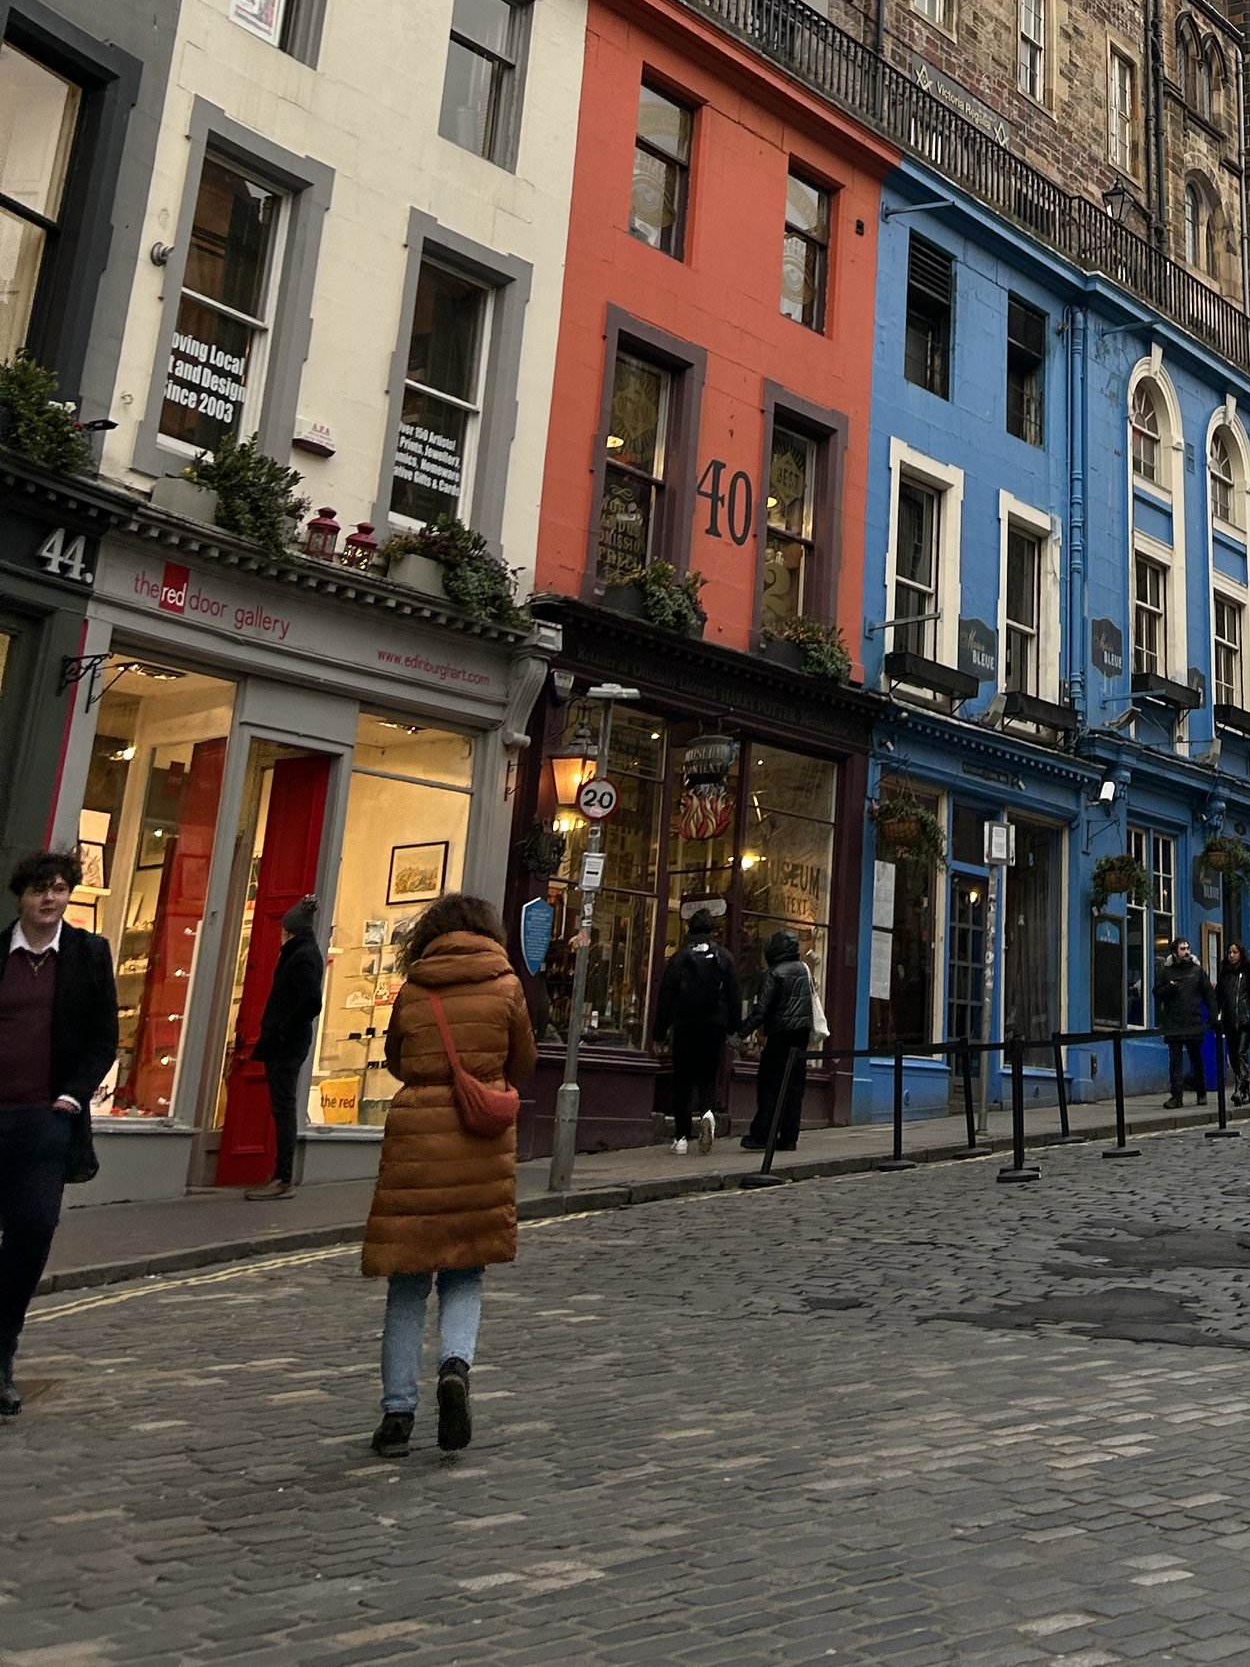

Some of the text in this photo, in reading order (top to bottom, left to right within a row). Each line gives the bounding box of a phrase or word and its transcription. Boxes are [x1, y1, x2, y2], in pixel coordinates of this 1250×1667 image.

[937, 81, 991, 130] Victoria Regalia
[172, 332, 209, 363] oving
[209, 344, 246, 376] Local
[164, 379, 234, 424] ince 2003
[174, 359, 202, 385] and
[201, 367, 246, 403] Design
[776, 467, 801, 490] BEST
[697, 459, 753, 546] 40
[133, 570, 291, 640] the red door gallery
[377, 650, 490, 686] www.edinburghart.com
[972, 649, 995, 670] BLEUE
[583, 789, 614, 809] 20
[768, 860, 821, 900] USEUM
[320, 1094, 337, 1109] the
[338, 1093, 355, 1109] red
